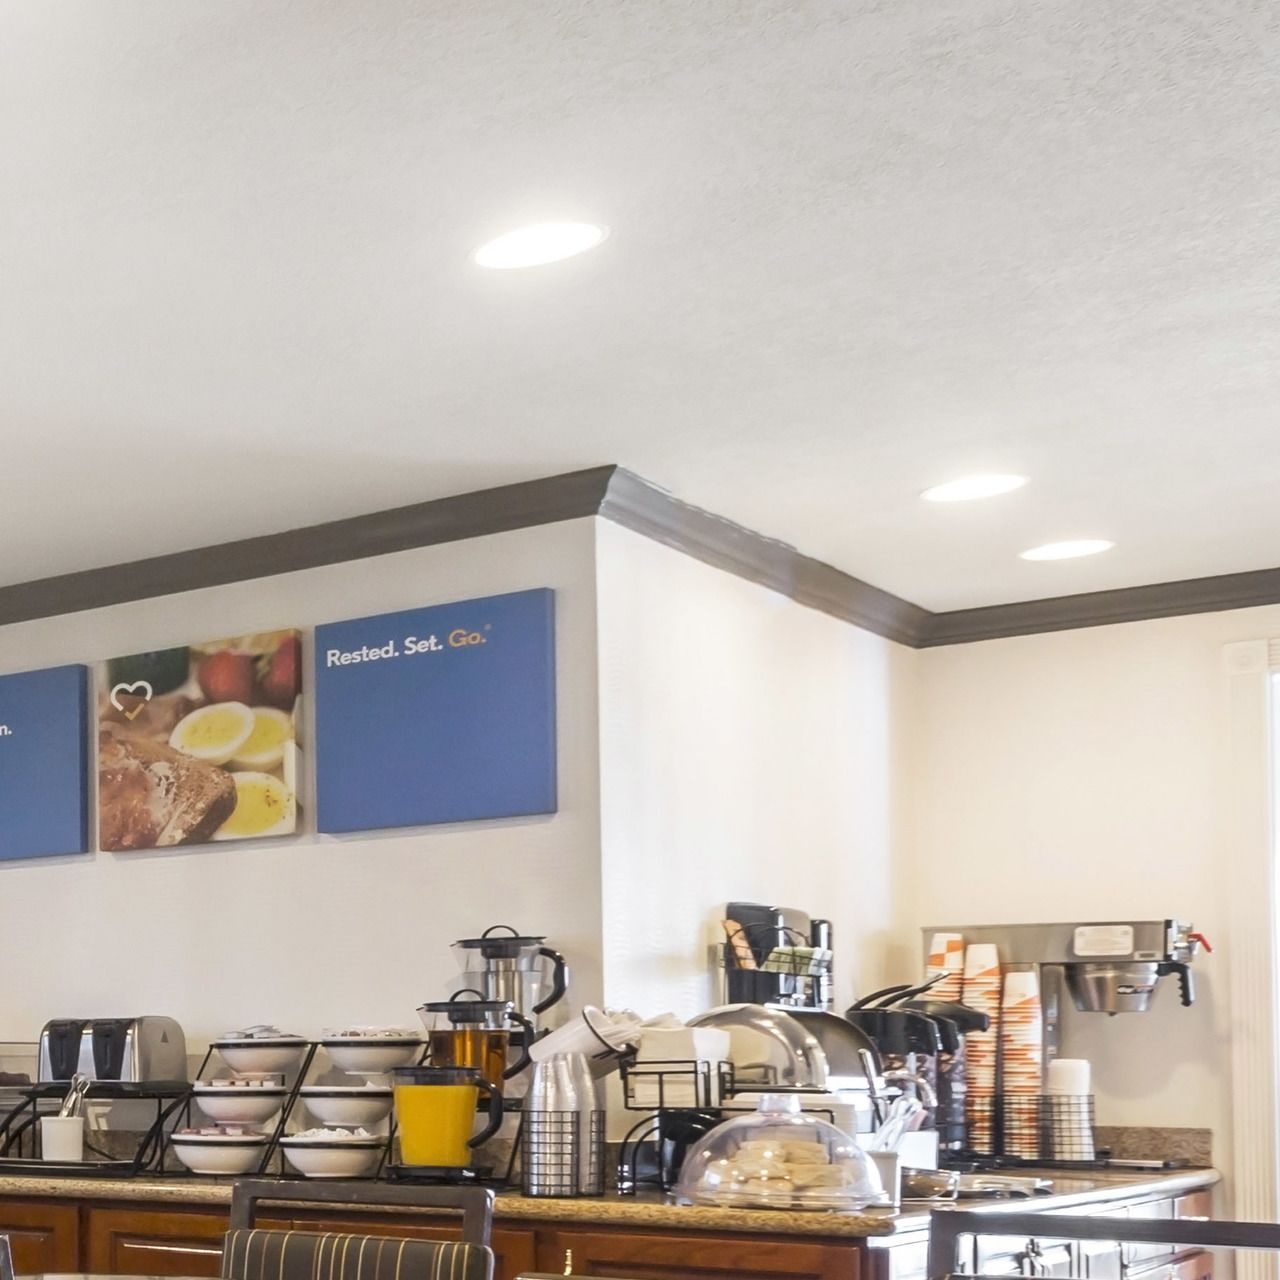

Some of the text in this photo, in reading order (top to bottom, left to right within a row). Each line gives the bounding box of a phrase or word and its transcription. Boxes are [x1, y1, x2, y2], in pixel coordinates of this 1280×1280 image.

[326, 628, 487, 668] Rested. Set. Go.
